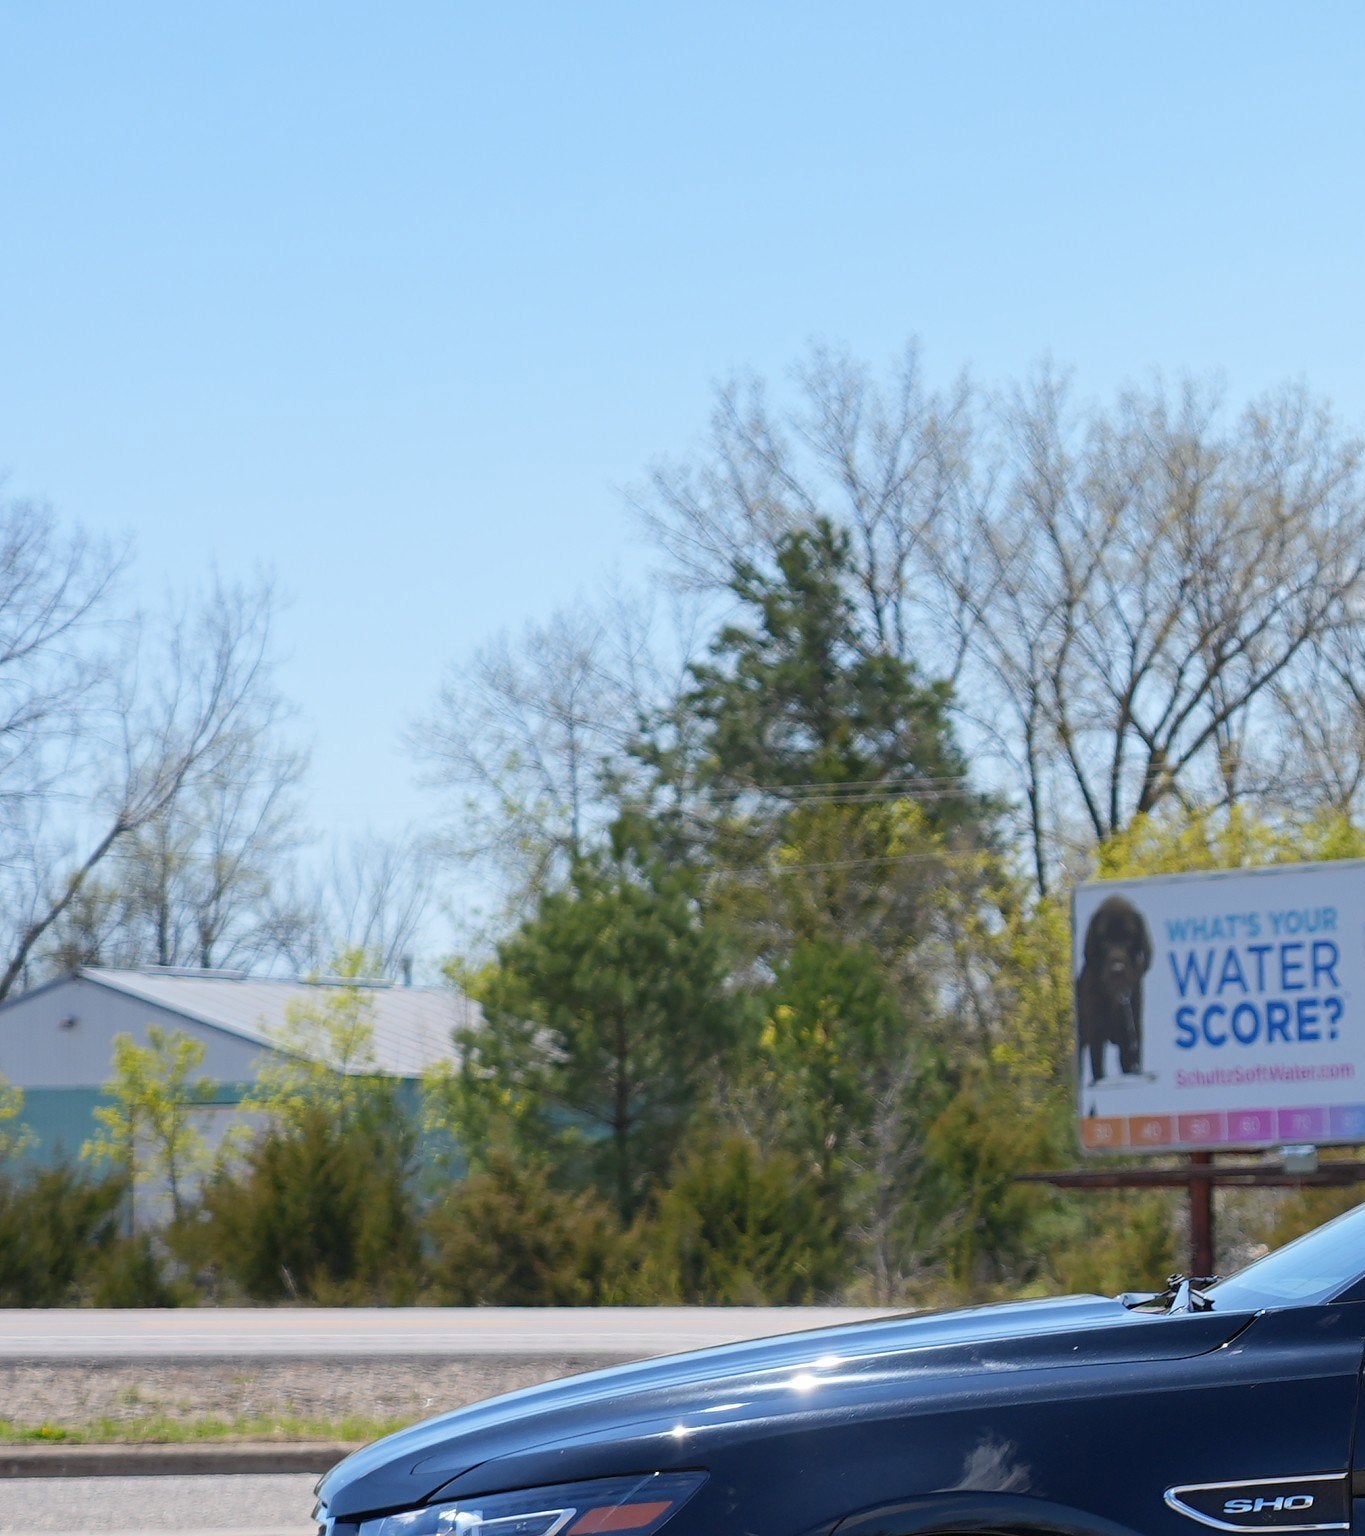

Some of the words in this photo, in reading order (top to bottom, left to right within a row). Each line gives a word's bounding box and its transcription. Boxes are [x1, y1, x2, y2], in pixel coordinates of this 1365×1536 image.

[1164, 913, 1263, 942] WHAT'S
[1271, 907, 1338, 935] YOUR
[1168, 939, 1343, 998] WATER
[1174, 997, 1345, 1050] SCORE?
[1222, 1495, 1314, 1515] SHO
